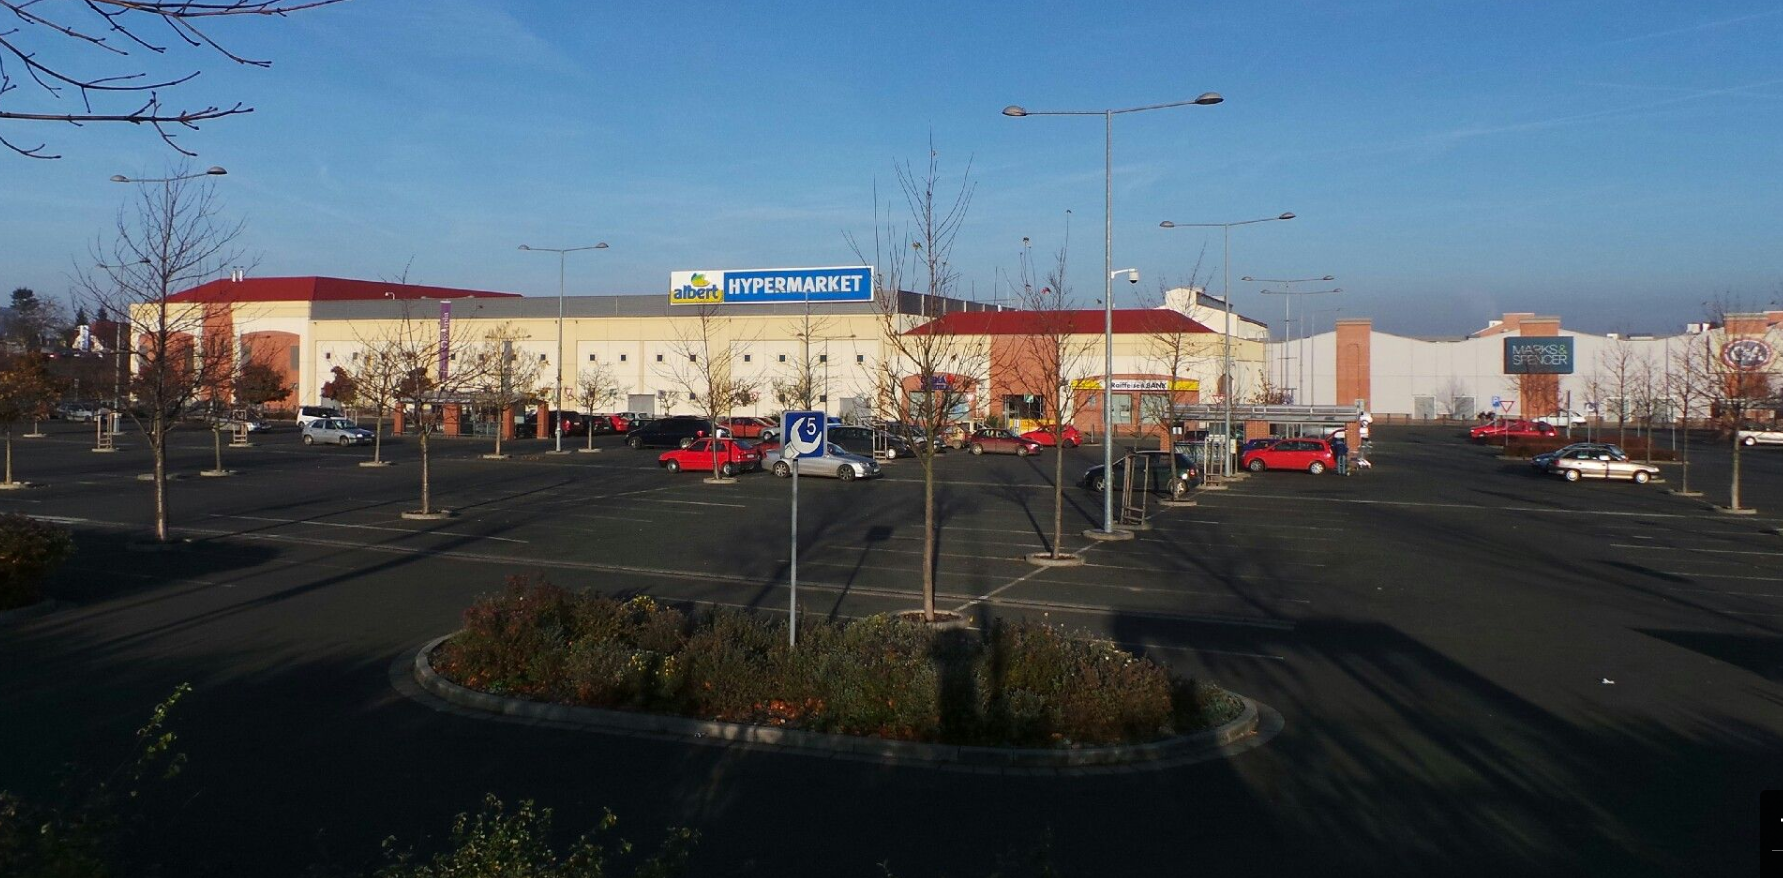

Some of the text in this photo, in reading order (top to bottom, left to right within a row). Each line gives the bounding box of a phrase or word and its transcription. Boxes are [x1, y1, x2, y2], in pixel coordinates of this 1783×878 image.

[674, 275, 863, 300] albert HYPERMARKET
[1512, 345, 1558, 355] MARKS
[1512, 355, 1568, 366] SPENCER
[806, 417, 817, 436] 5
